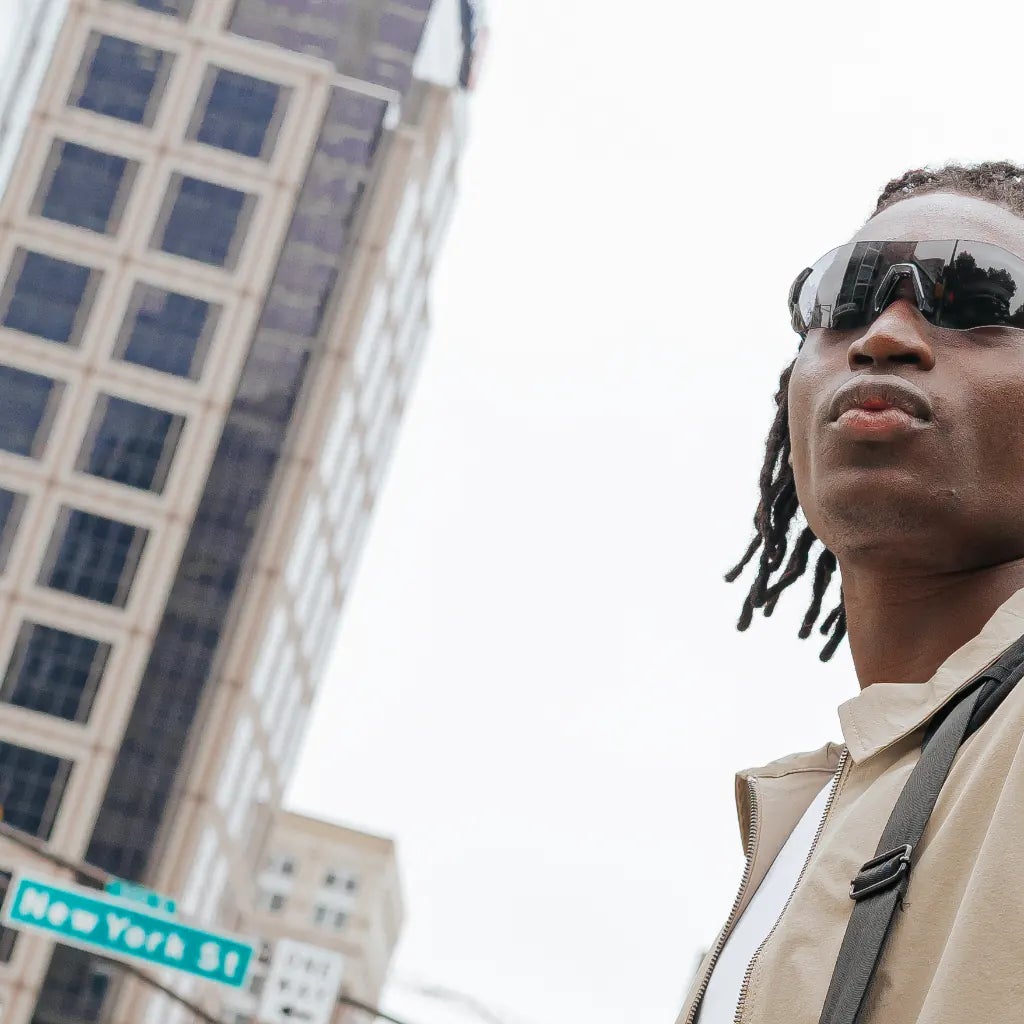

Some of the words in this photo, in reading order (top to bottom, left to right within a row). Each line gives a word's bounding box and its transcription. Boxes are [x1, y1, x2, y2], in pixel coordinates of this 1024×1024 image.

[19, 887, 99, 934] New
[106, 912, 186, 961] York
[197, 942, 239, 978] St
